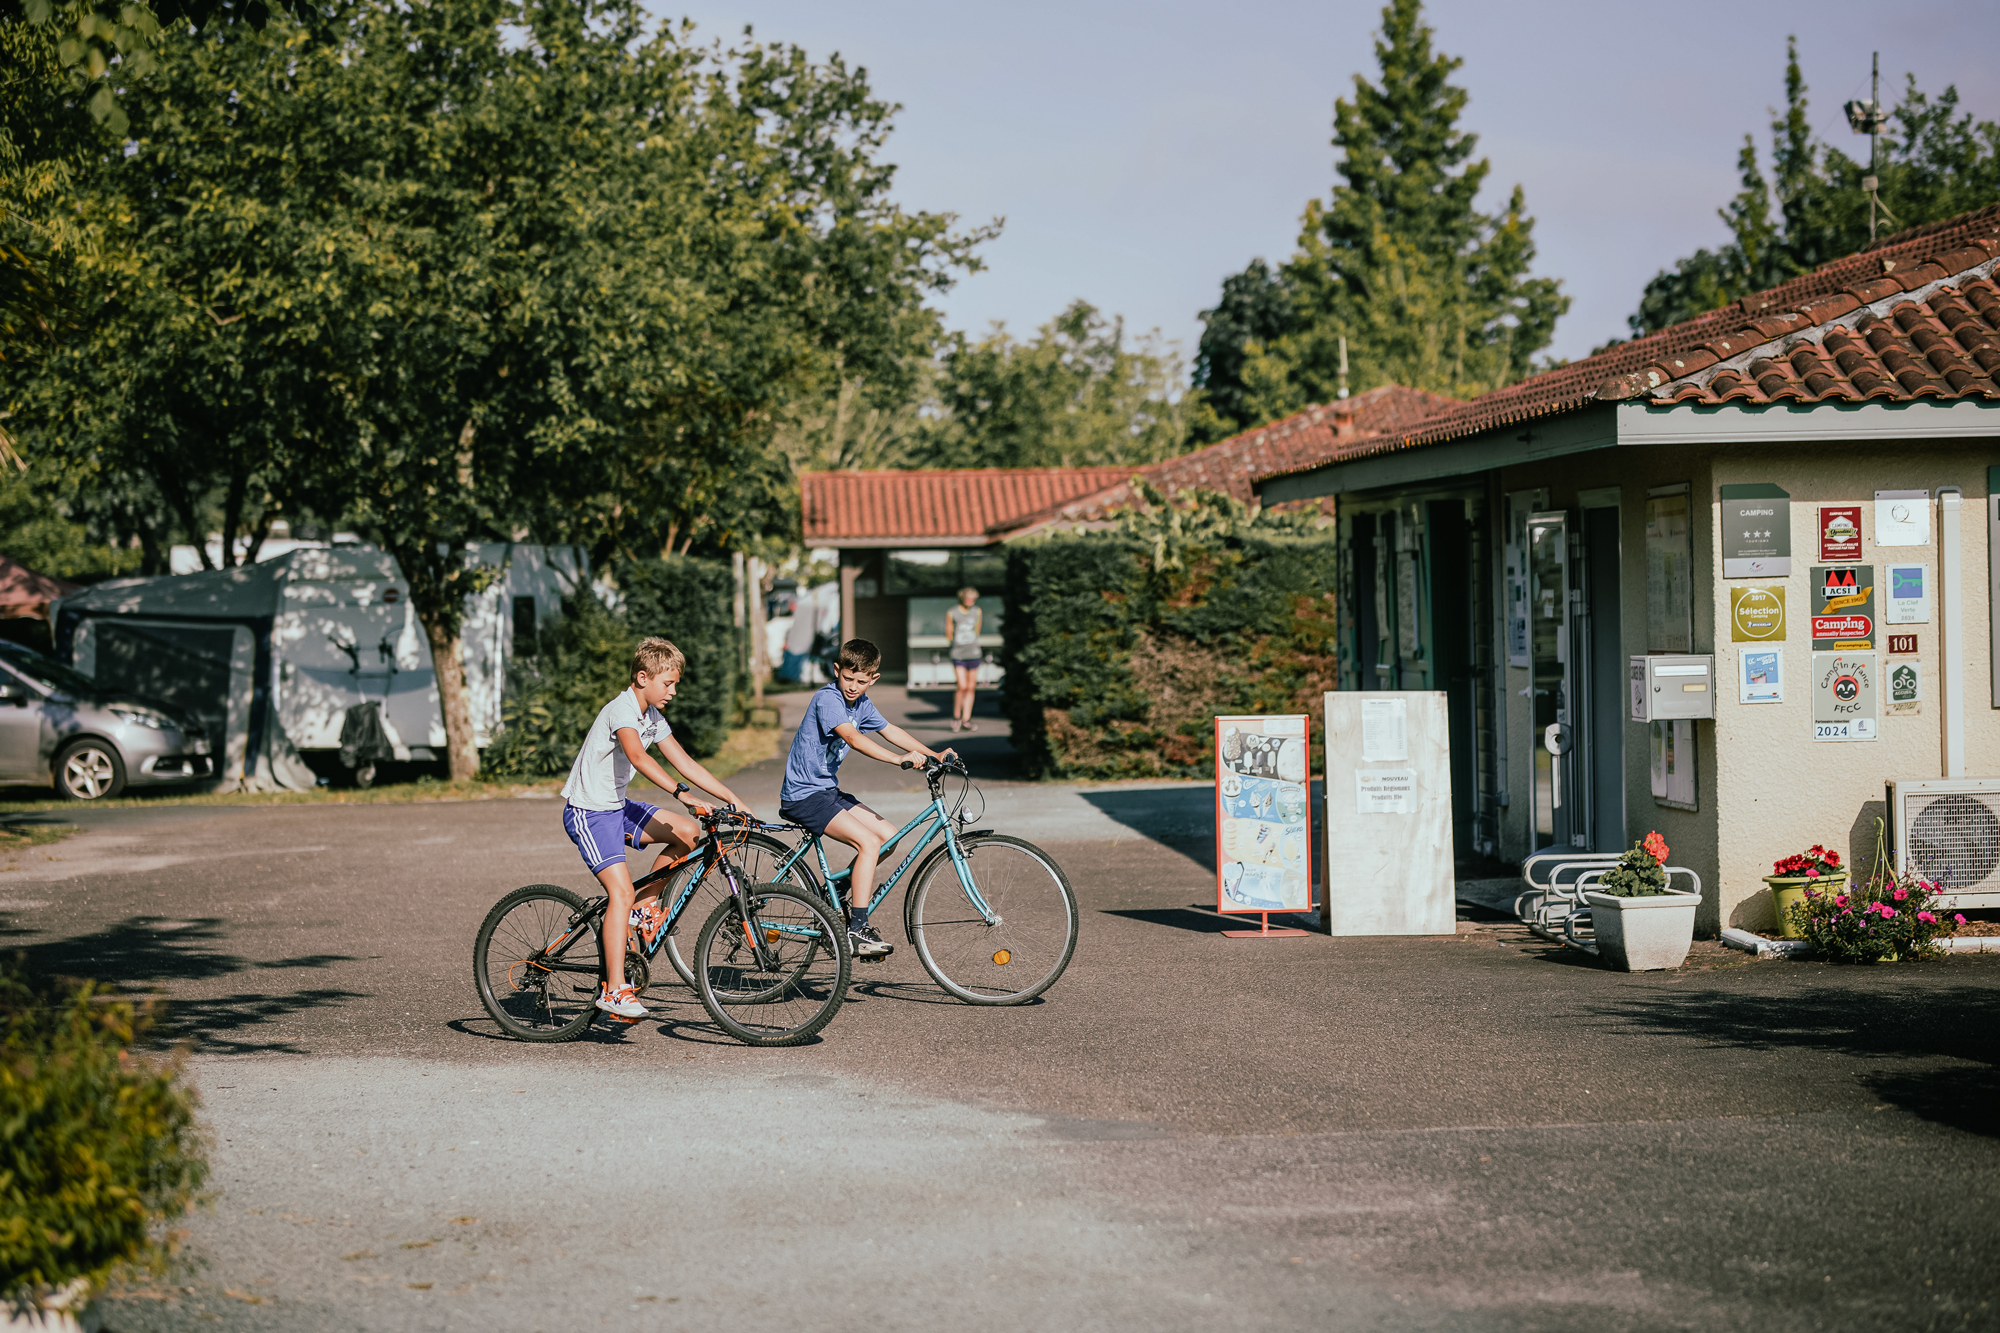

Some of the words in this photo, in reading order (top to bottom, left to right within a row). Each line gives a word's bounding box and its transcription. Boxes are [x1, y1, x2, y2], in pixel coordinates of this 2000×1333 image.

[1830, 585, 1851, 595] ACSI
[1740, 606, 1779, 615] Sélection
[1815, 616, 1865, 630] Camping
[1893, 637, 1914, 651] 101
[1834, 702, 1861, 713] FFCC
[1817, 726, 1848, 736] 2024
[648, 862, 706, 954] LAPIERRE
